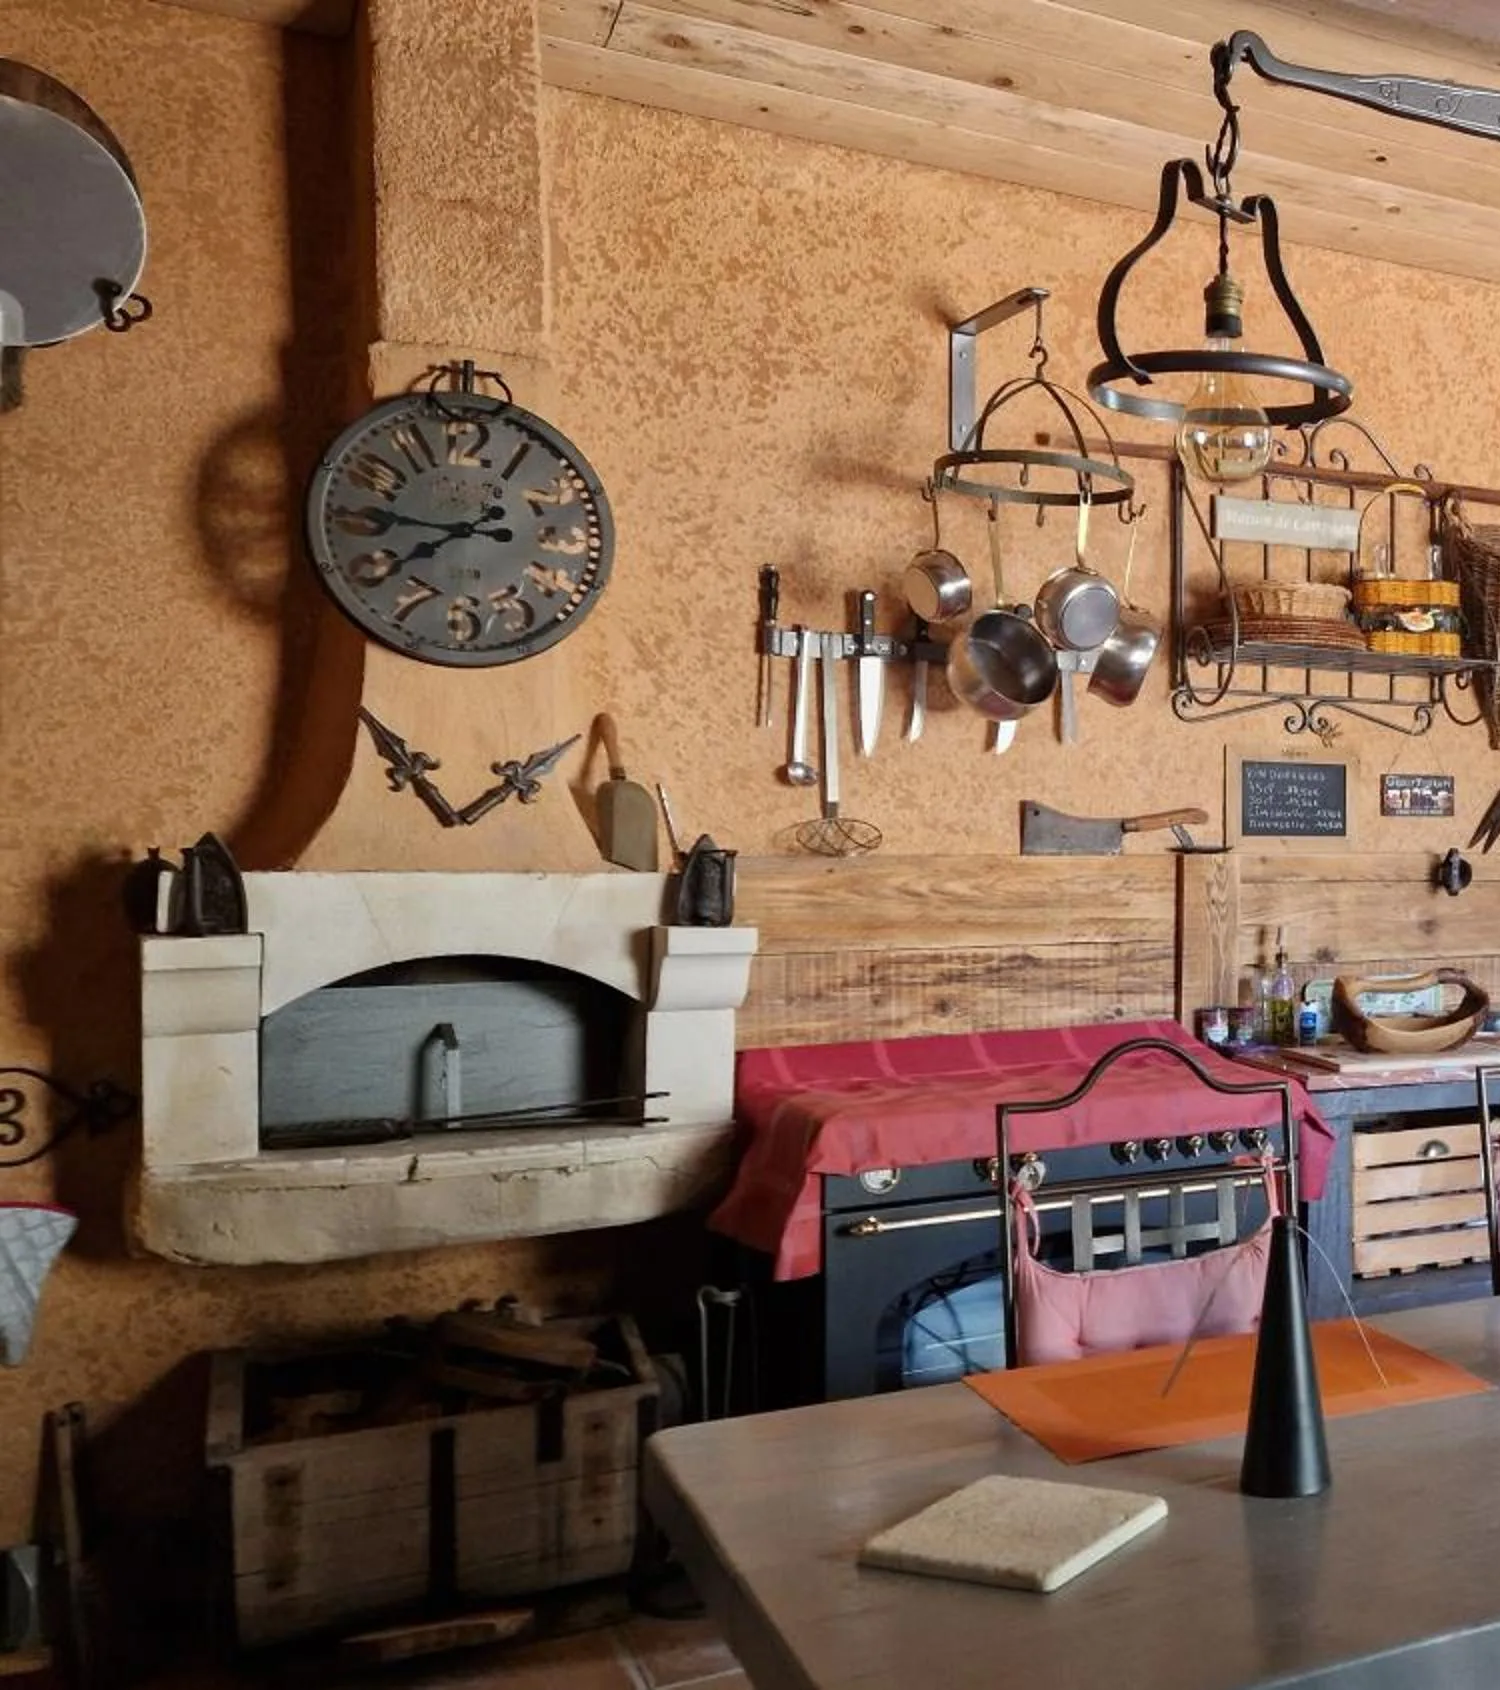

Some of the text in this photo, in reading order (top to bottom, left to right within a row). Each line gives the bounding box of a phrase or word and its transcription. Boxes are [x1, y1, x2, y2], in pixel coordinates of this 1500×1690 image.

[442, 421, 492, 468] 12
[501, 441, 532, 481] 1
[390, 575, 444, 622] 7
[447, 594, 481, 642] 6
